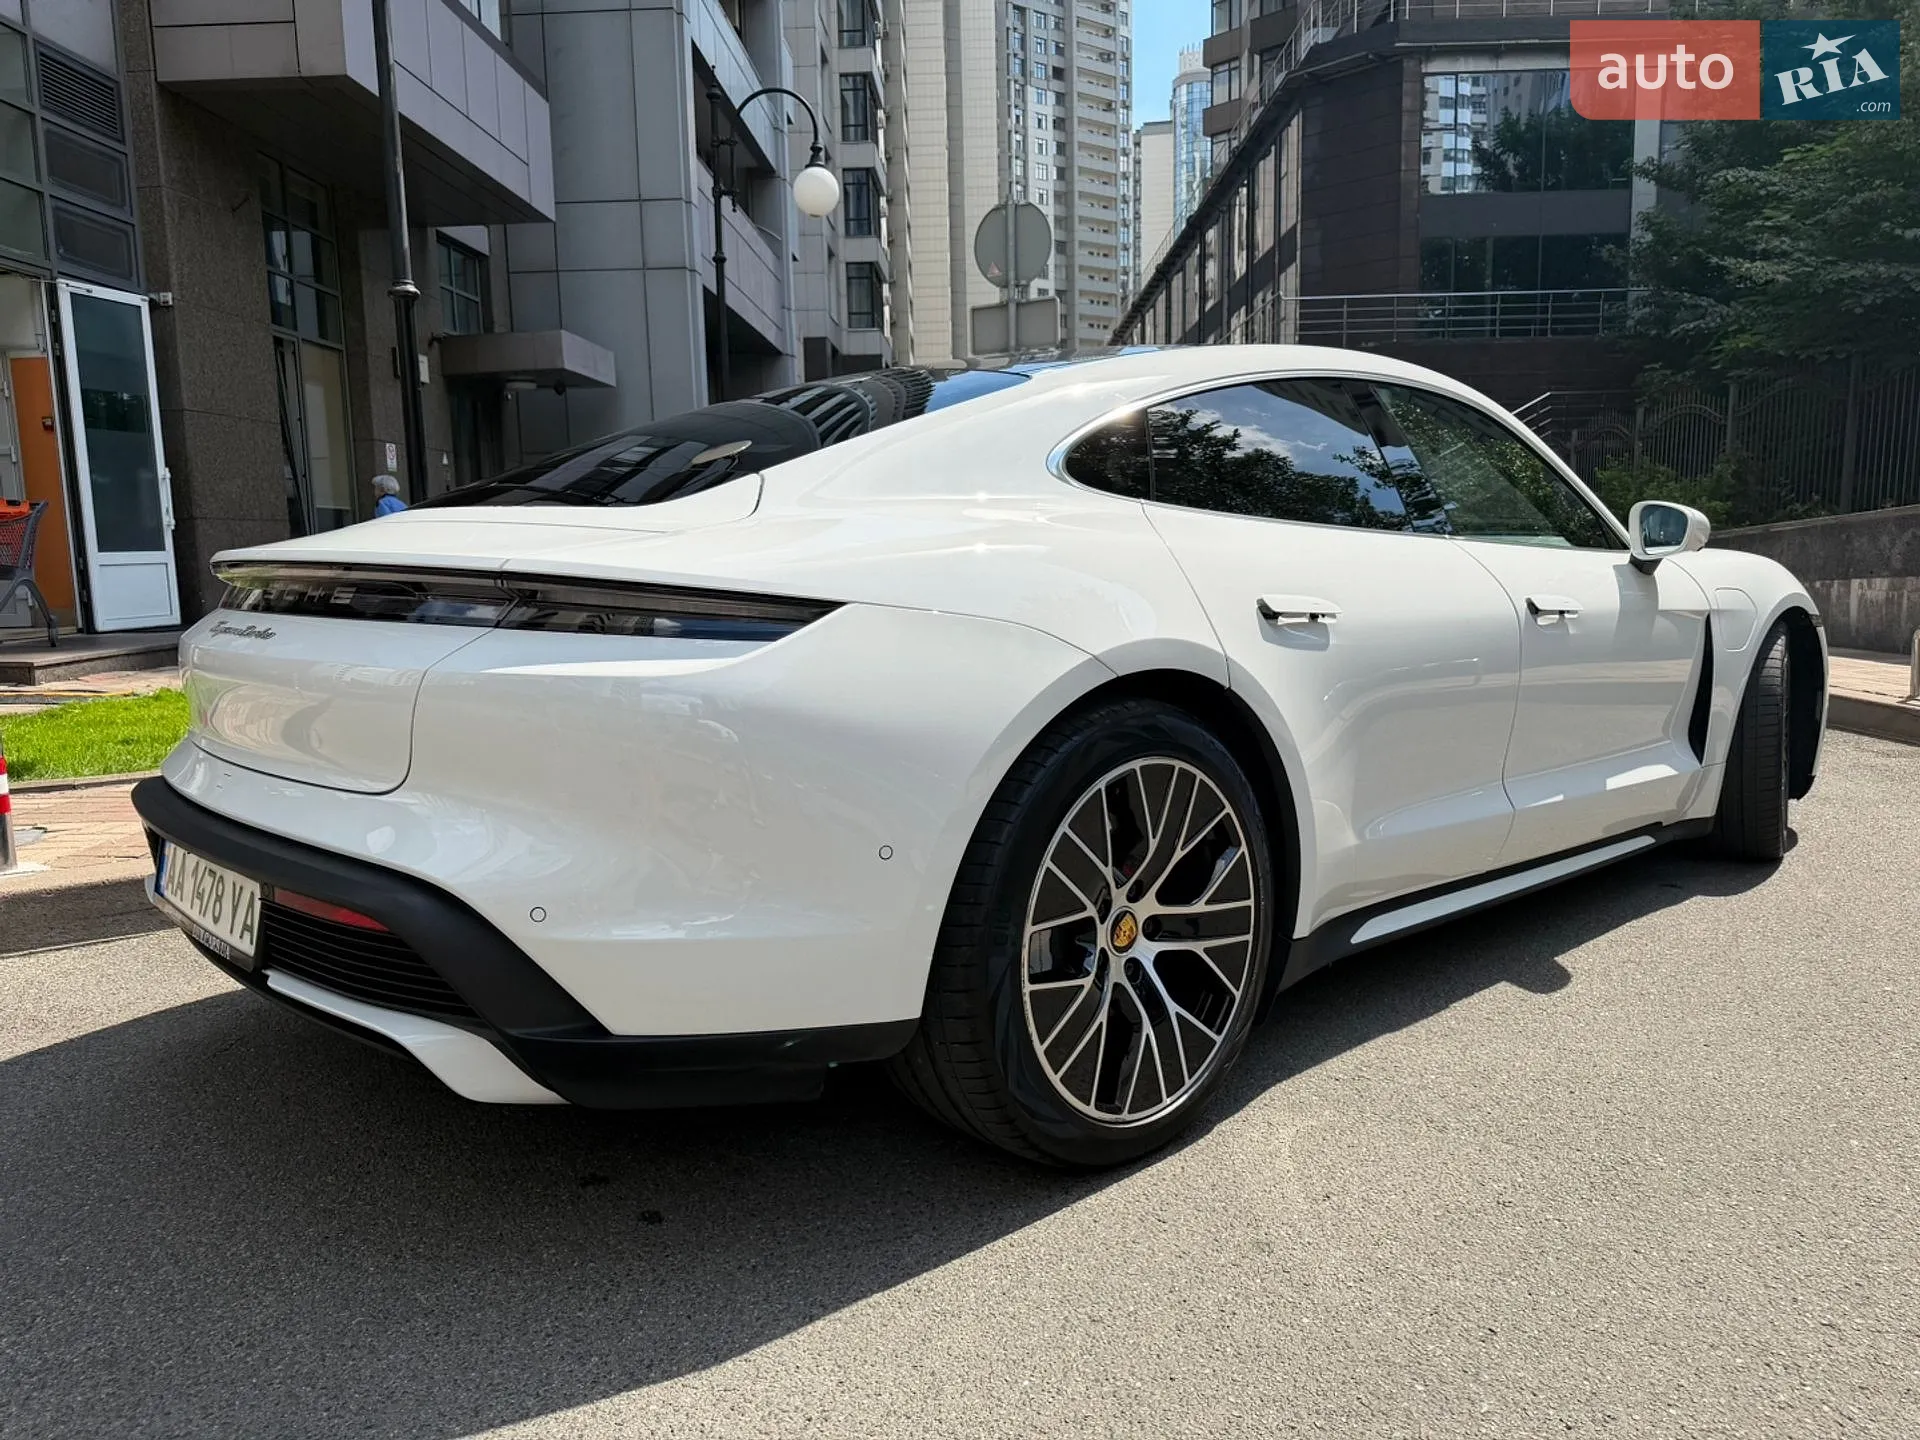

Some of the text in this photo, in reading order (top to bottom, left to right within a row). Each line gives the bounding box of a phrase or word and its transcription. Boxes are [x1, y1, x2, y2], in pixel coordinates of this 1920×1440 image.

[167, 847, 255, 946] AA 1478 YA
